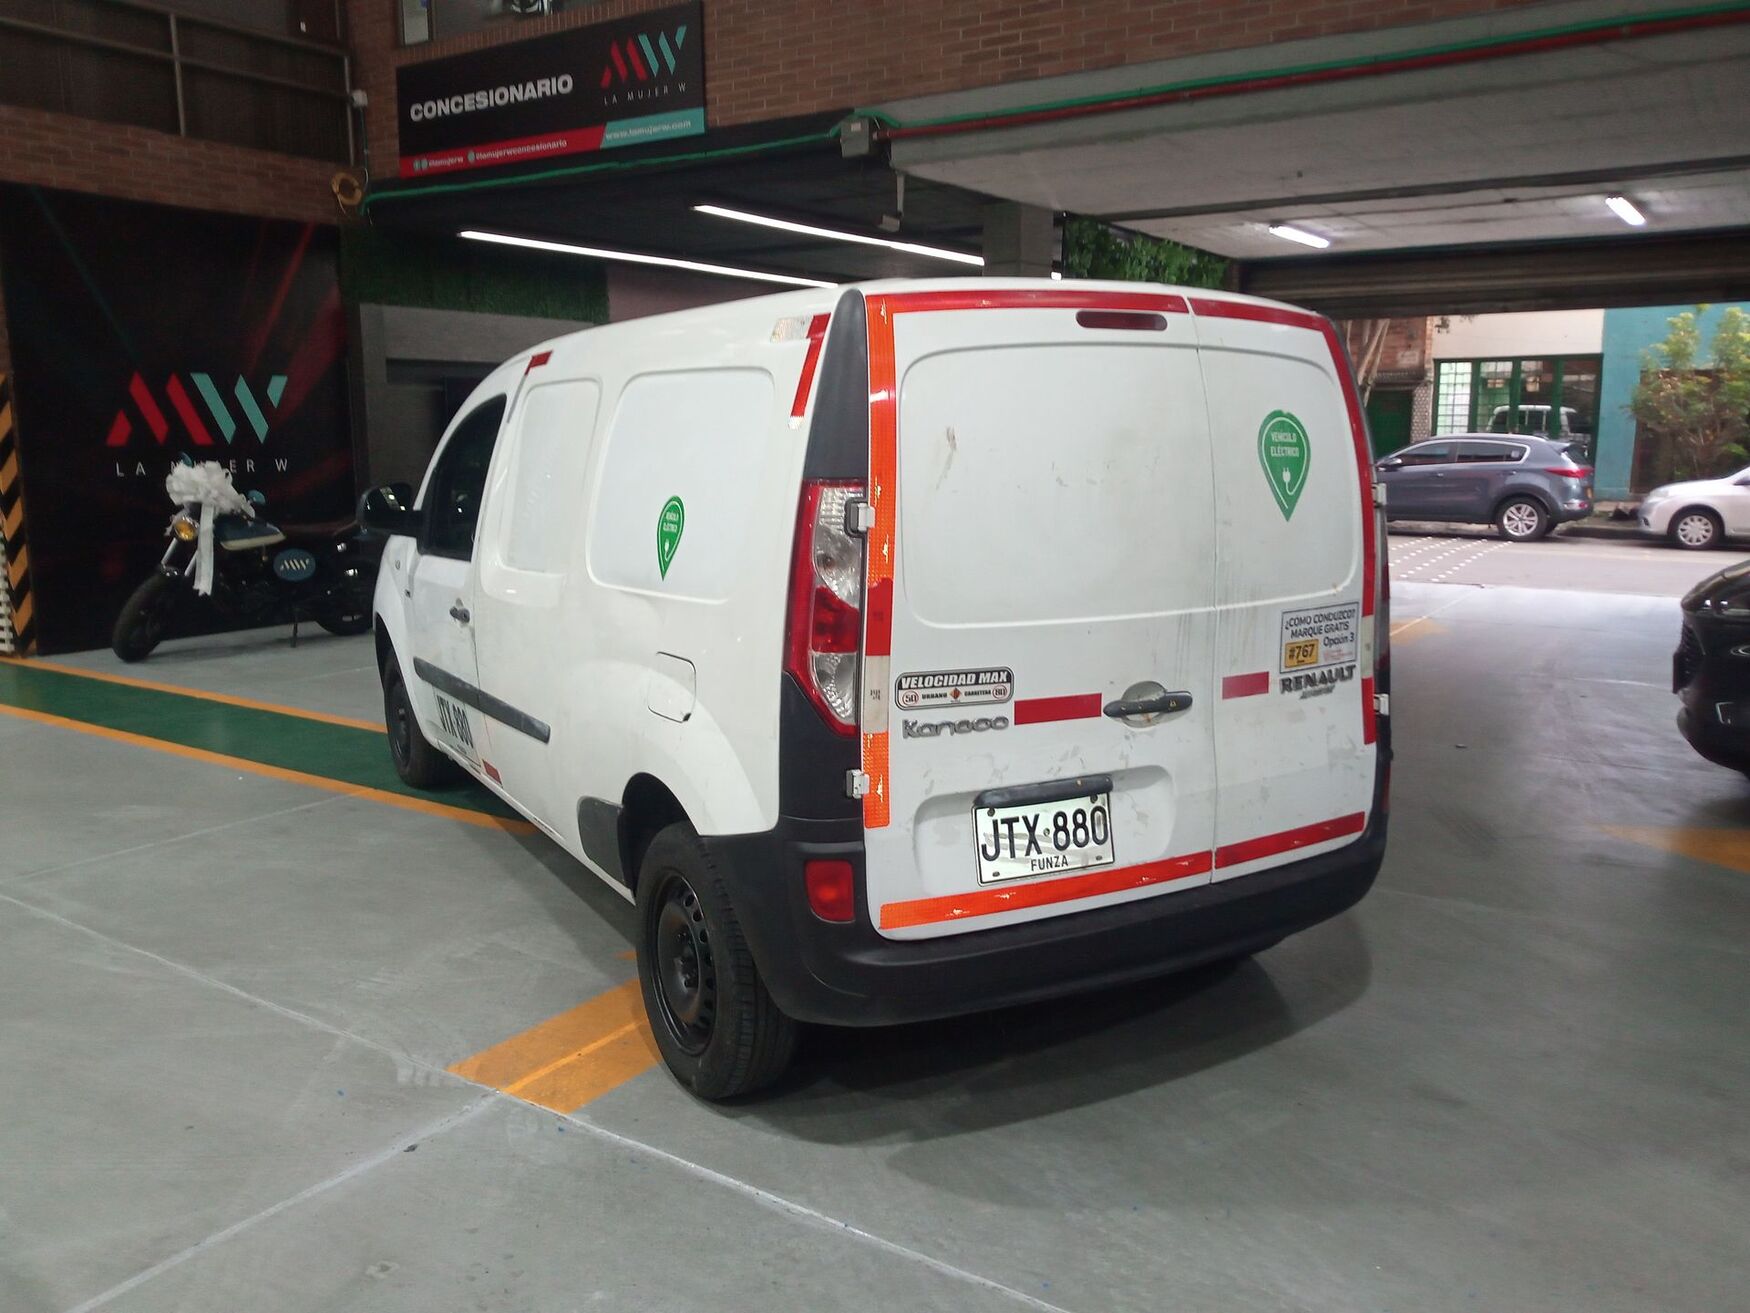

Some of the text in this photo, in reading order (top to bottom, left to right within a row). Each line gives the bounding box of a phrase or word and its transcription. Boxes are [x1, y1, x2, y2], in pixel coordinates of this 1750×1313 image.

[409, 73, 574, 122] CONCESIONARIO
[603, 82, 687, 106] LA MUJER W
[115, 461, 146, 478] LA
[274, 458, 288, 473] W
[1313, 608, 1356, 624] CONDUZCO?
[1290, 621, 1350, 639] MARQUE GRATIS
[1349, 632, 1355, 643] 3
[1288, 643, 1315, 660] #767
[901, 671, 1008, 690] VELOCIDAD MAX
[1280, 664, 1356, 695] RENAULT
[981, 806, 1109, 862] JTX 880
[1030, 855, 1068, 872] FUNZA
